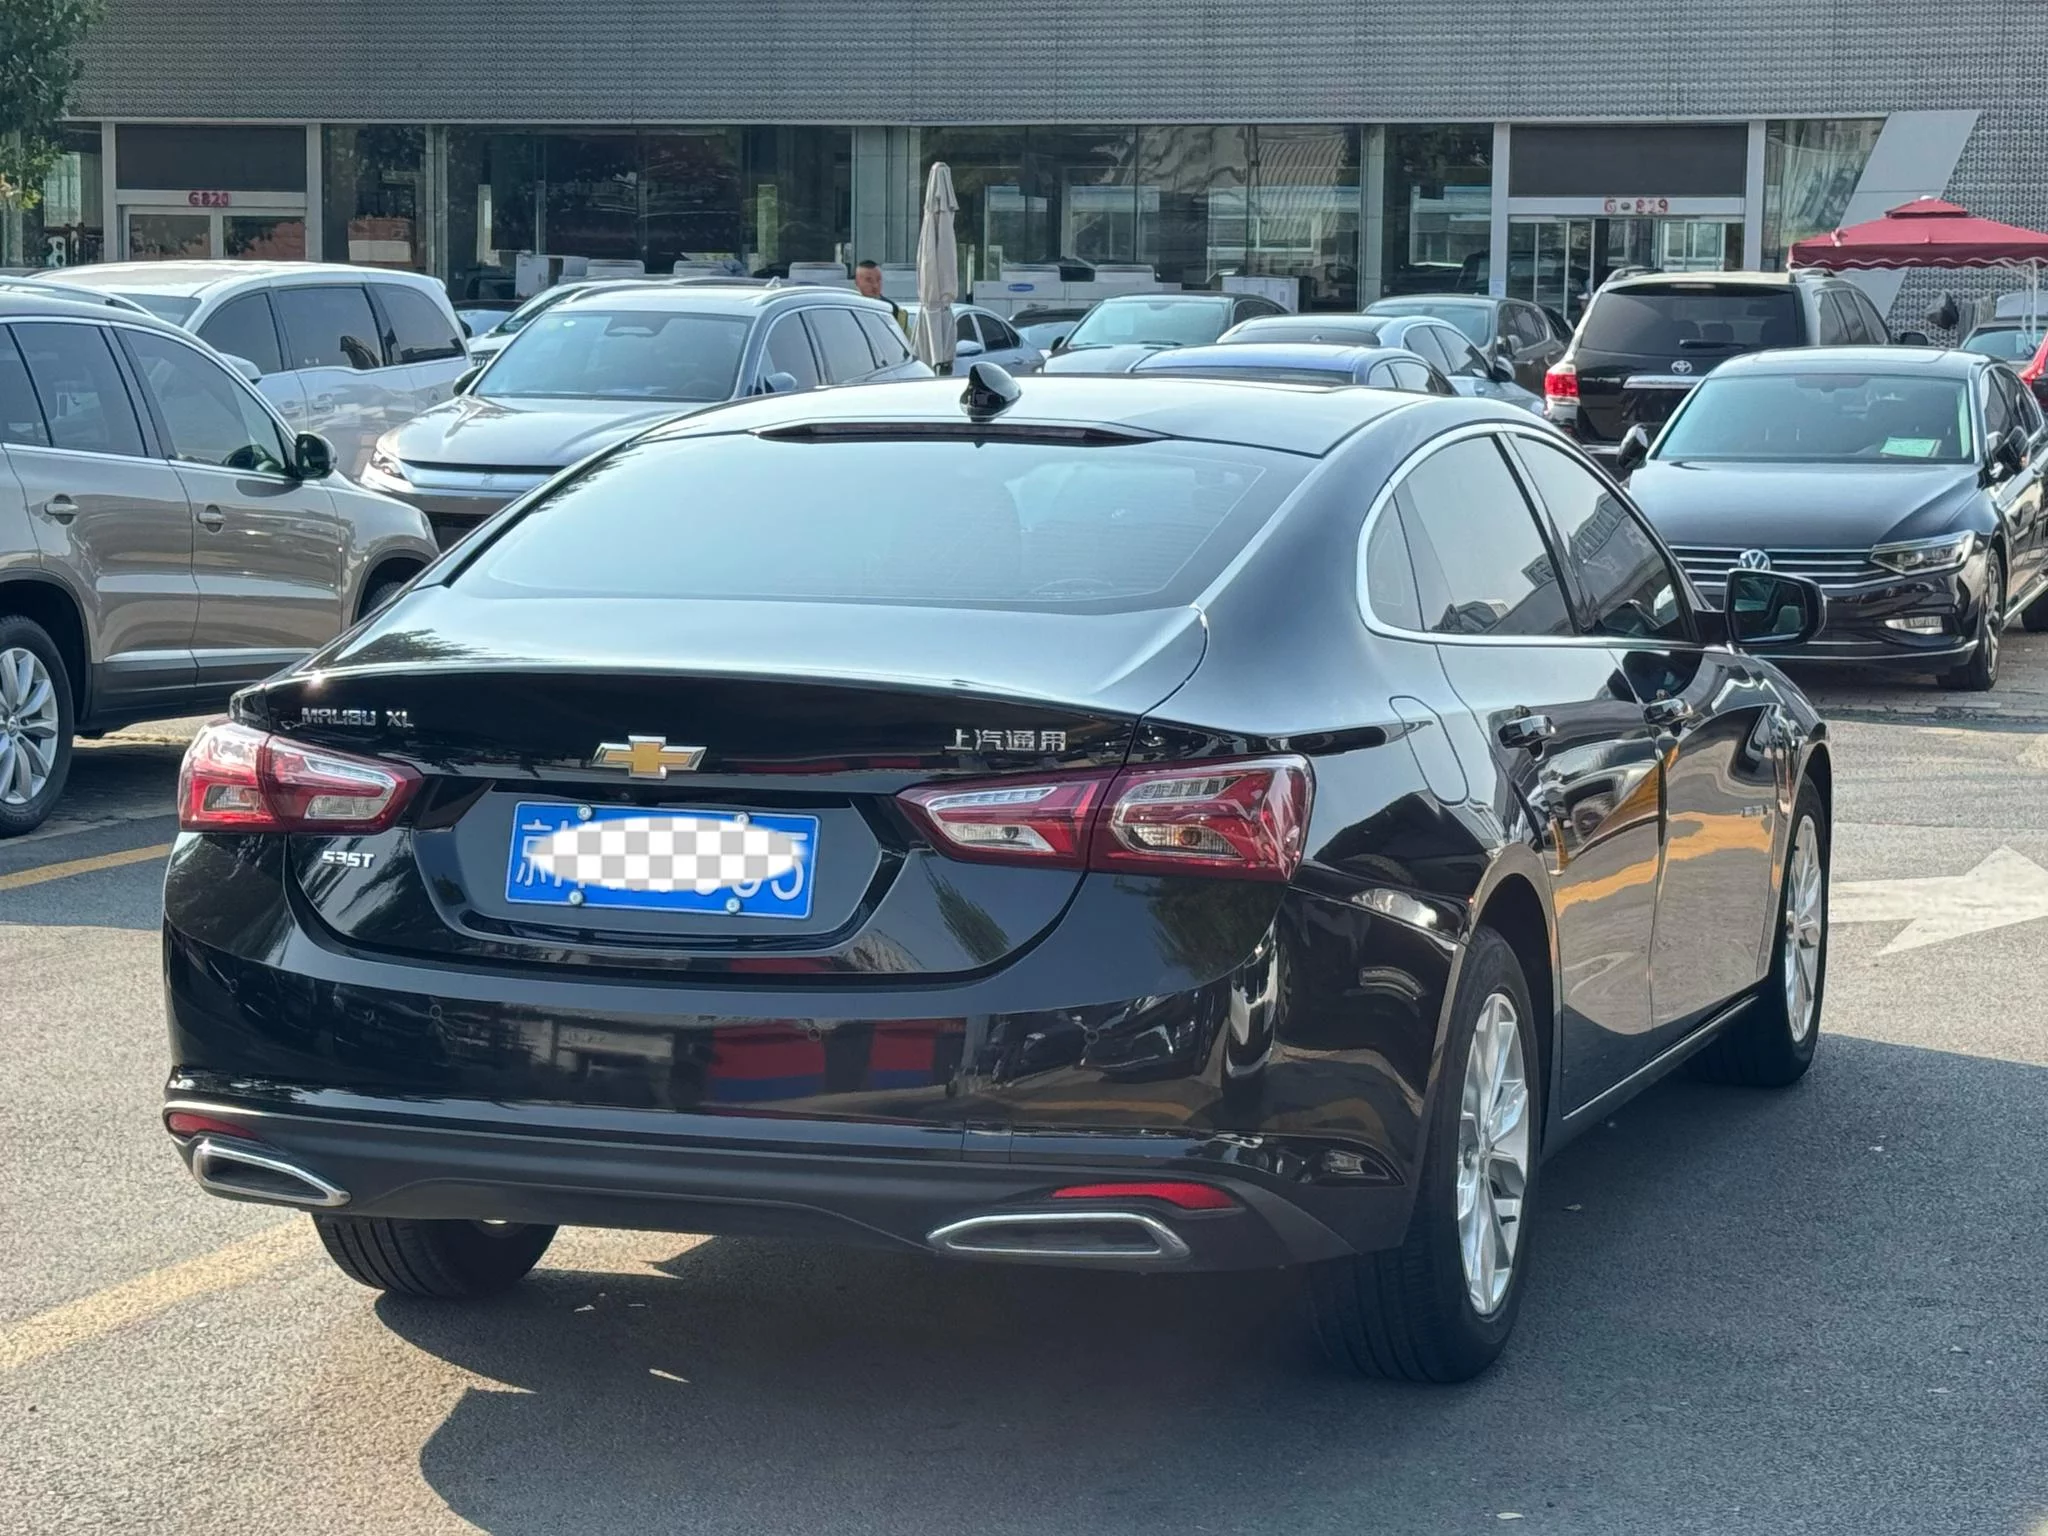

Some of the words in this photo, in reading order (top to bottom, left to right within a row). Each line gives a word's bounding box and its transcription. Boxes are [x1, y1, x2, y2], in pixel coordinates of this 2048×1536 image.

[189, 191, 229, 206] G820
[301, 707, 377, 726] MALIBU
[386, 710, 414, 728] XL
[944, 728, 1067, 752] 上汽通用
[321, 850, 375, 868] 535T
